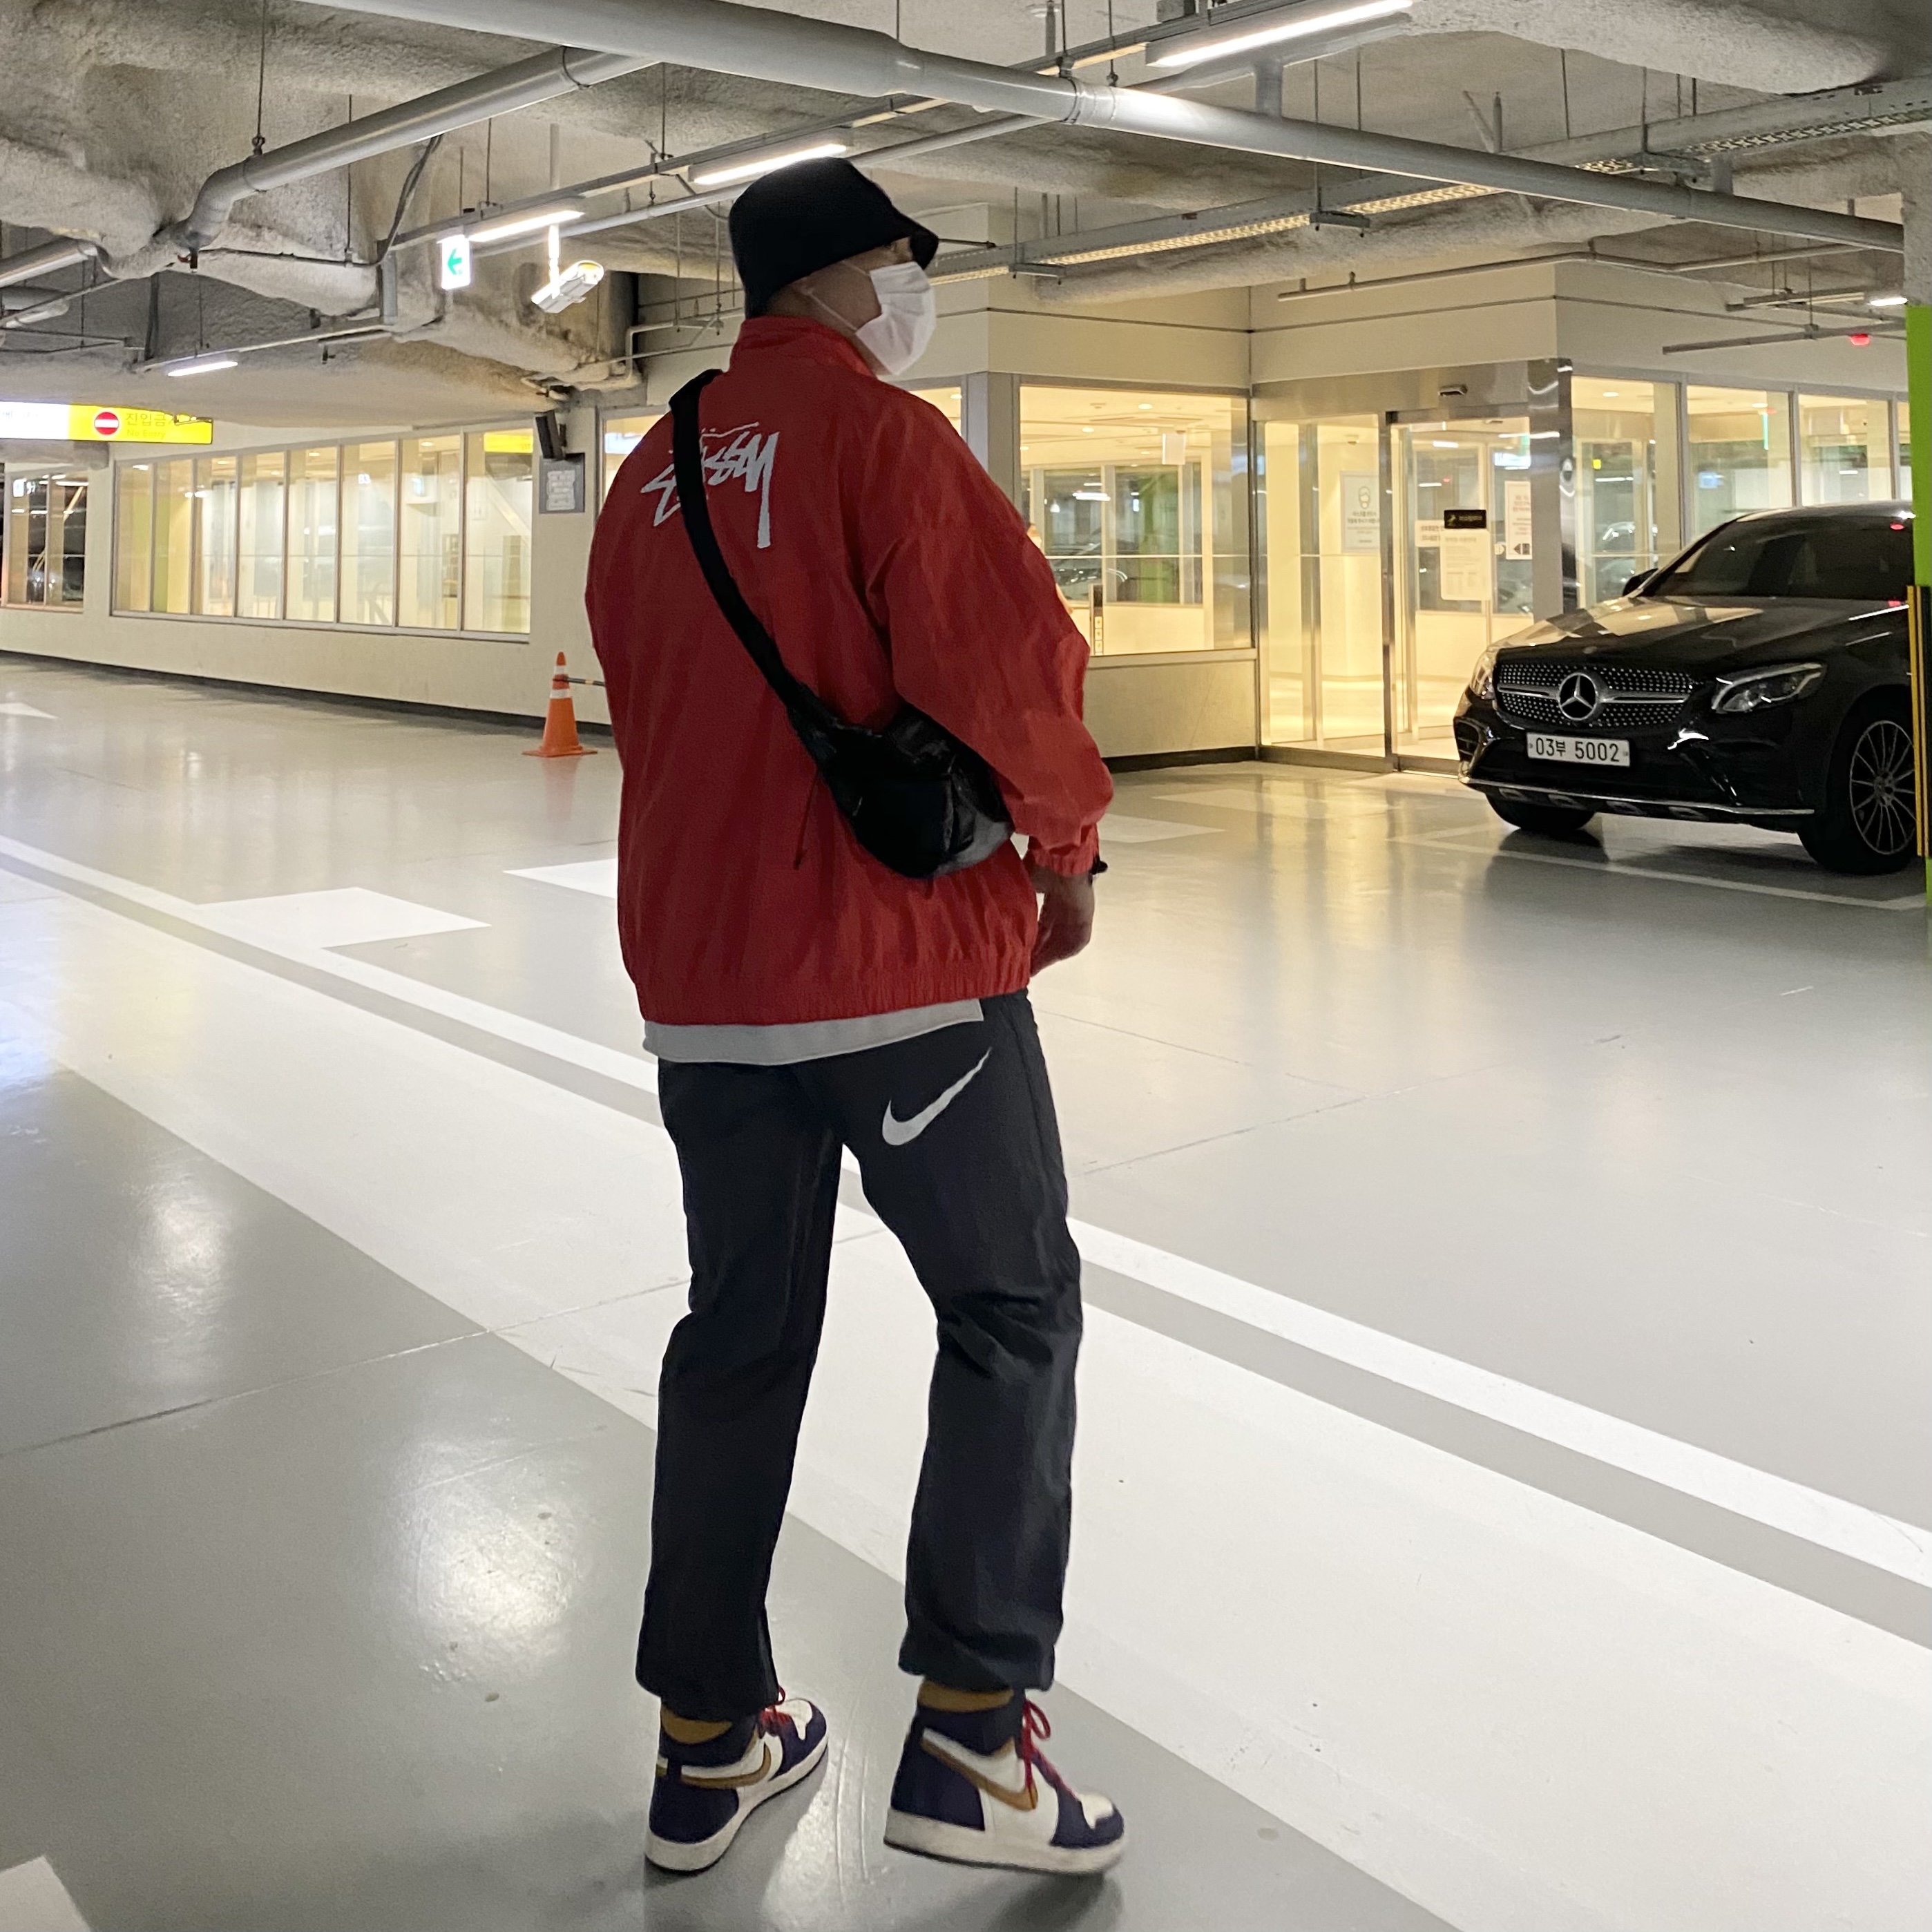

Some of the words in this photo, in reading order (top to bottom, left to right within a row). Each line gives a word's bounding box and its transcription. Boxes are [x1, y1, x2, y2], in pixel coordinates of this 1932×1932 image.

[126, 412, 178, 427] 진입금
[126, 429, 140, 437] No
[142, 430, 166, 440] Entry
[1536, 737, 1566, 757] 03부
[1575, 740, 1620, 763] 5002
